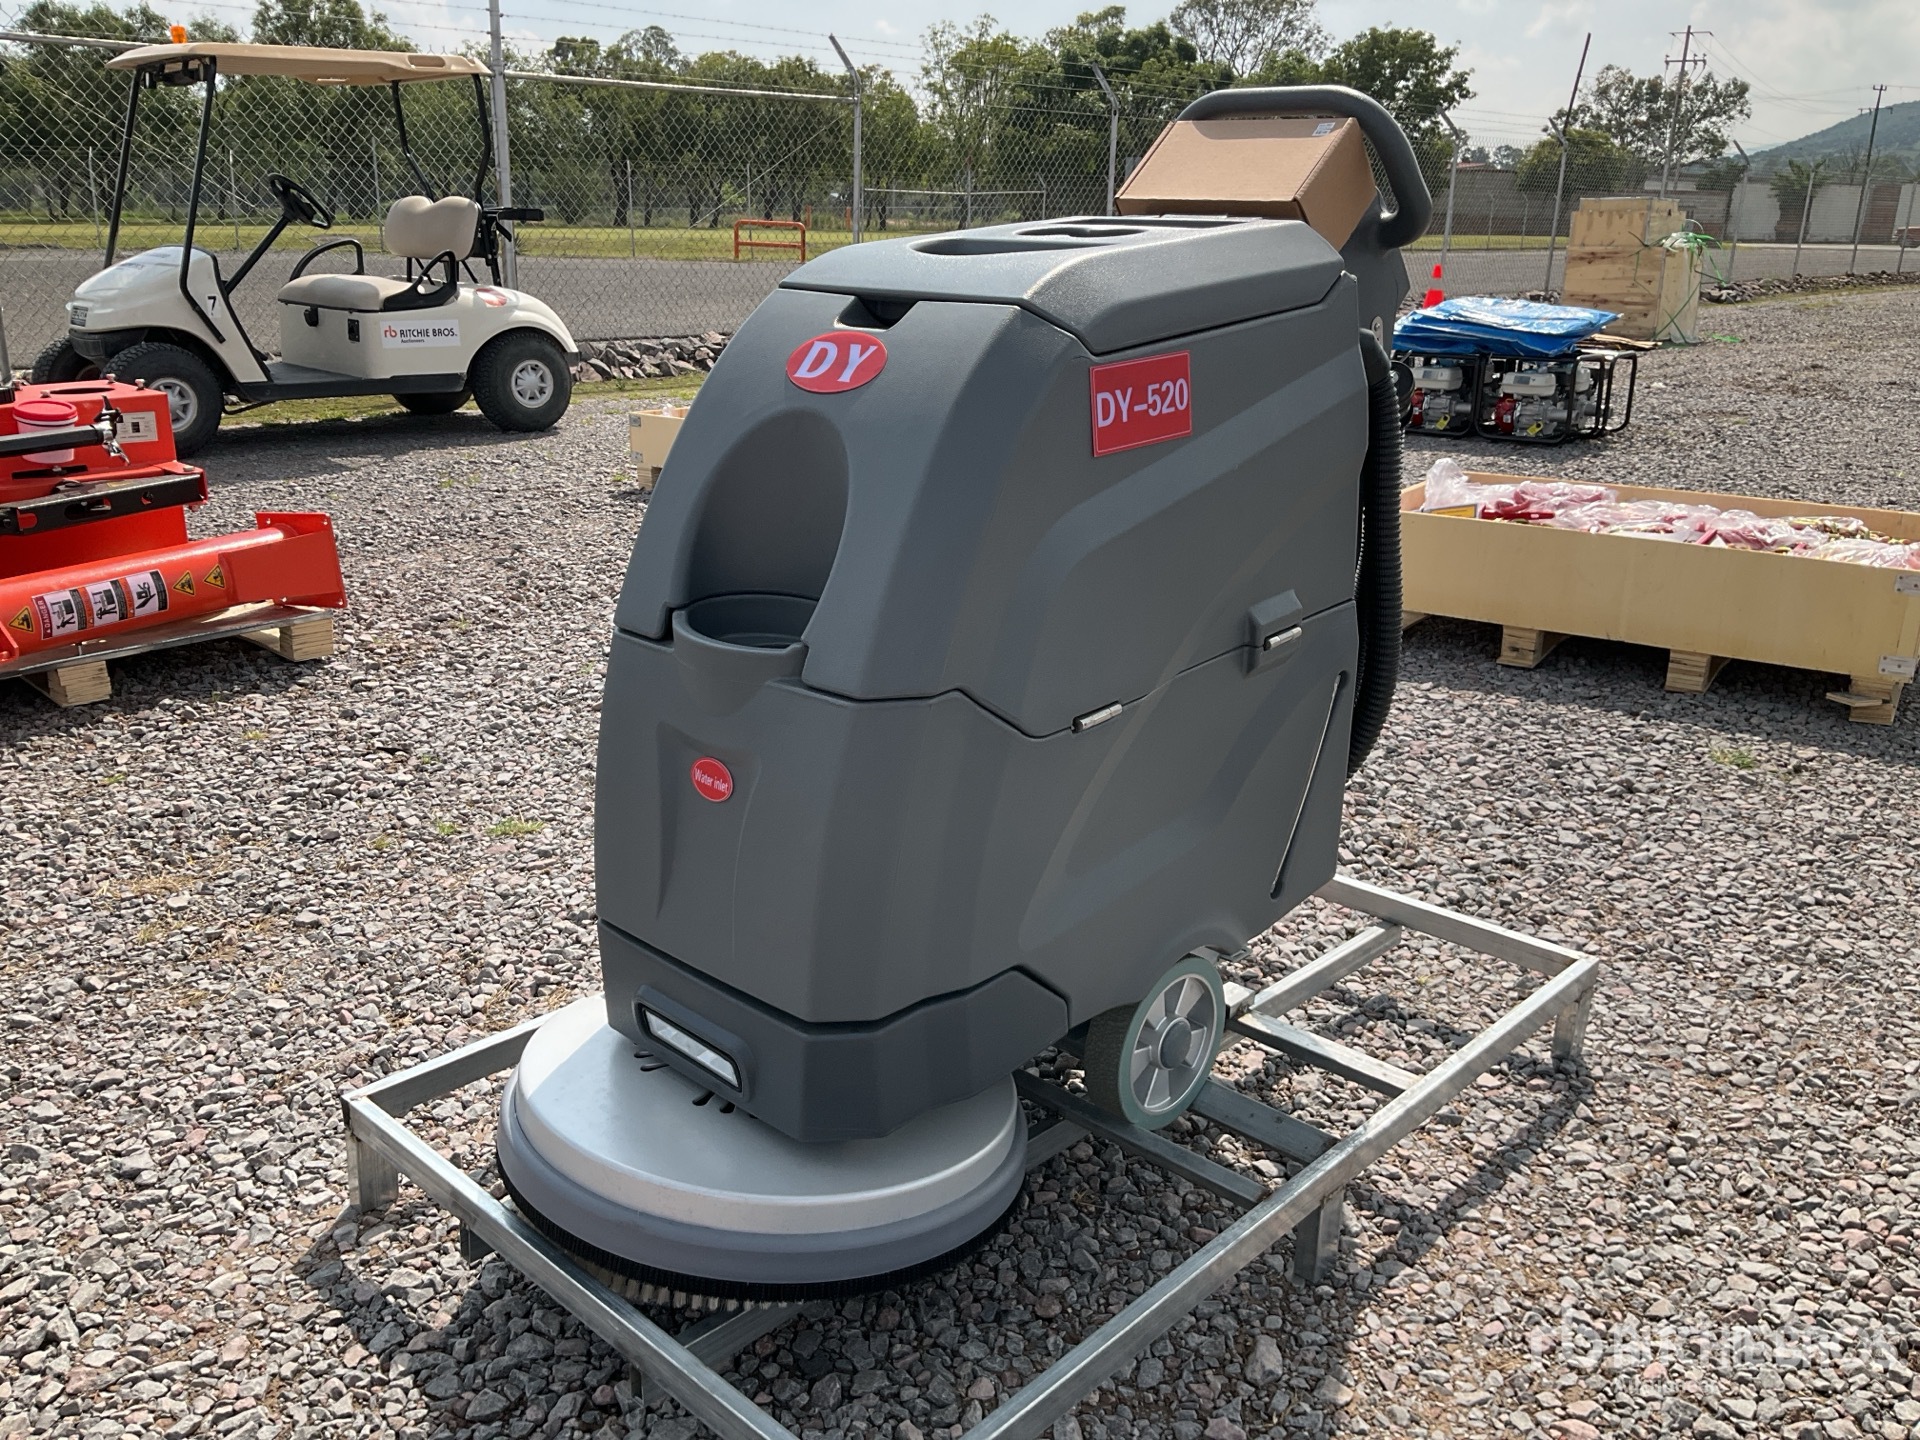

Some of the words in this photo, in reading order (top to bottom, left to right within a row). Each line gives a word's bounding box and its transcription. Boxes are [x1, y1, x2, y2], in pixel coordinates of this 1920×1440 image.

[207, 296, 217, 316] 7
[384, 325, 397, 338] rb
[400, 329, 430, 338] RITCHIE
[793, 340, 879, 383] DY
[1096, 378, 1189, 428] DY-520
[38, 600, 51, 628] DANGER
[694, 768, 713, 787] Water
[713, 776, 728, 794] inlet
